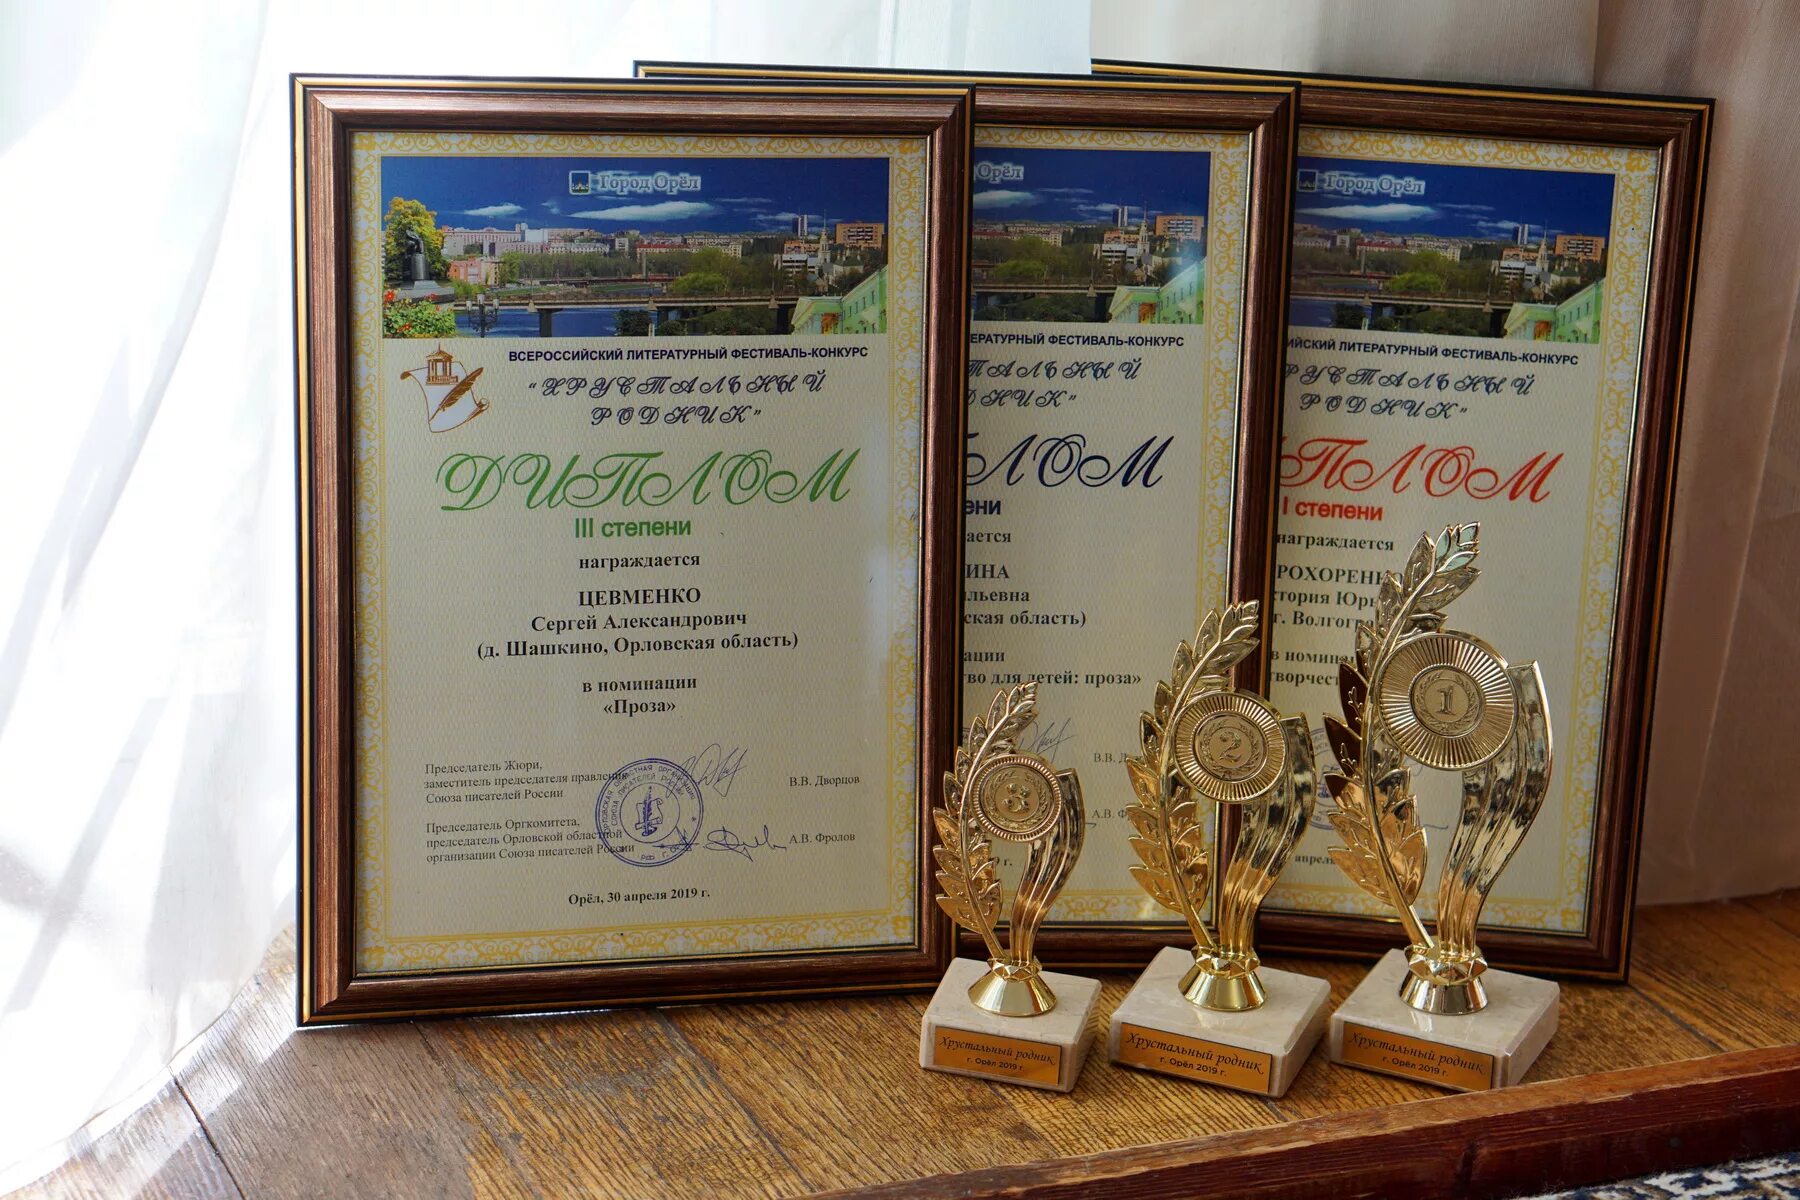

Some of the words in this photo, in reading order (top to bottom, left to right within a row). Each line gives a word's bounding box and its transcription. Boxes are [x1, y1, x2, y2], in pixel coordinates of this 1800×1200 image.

[600, 174, 650, 193] Город
[655, 173, 699, 193] Орёл
[977, 163, 1023, 183] Орёл
[1326, 173, 1375, 194] Город
[1380, 177, 1422, 196] Орёл
[1048, 334, 1185, 348] ФЕСТИВАЛЬ-КОНКУРС
[508, 347, 624, 363] ВСЕРОССИЙСКИЙ
[626, 346, 728, 361] ЛИТЕРАТУРНЫЙ
[731, 346, 868, 360] ФЕСТИВАЛЬ-КОНКУРС
[1338, 340, 1438, 358] ЛИТЕРАТУРНЫЙ
[1441, 346, 1580, 366] ФЕСТИВАЛЬ-КОНКУРС
[966, 432, 1175, 488] ЛОМ
[1279, 435, 1565, 503] ПЛОМ
[435, 447, 861, 512] ДИПЛОМ
[1295, 500, 1384, 522] степени
[575, 518, 594, 539] III
[601, 519, 692, 538] степени
[1276, 532, 1395, 552] награждается
[578, 554, 701, 573] награждается
[578, 586, 702, 610] ЦЕВМЕНКО
[965, 591, 1030, 602] льевна
[531, 614, 597, 635] Сергей
[603, 611, 748, 632] Александрович
[1009, 610, 1087, 629] область)
[477, 642, 500, 660] (д.
[506, 639, 609, 659] Шашкино,
[614, 636, 716, 656] Орловская
[721, 631, 799, 651] область)
[582, 681, 593, 693] в
[598, 677, 698, 693] номинации
[991, 672, 1021, 686] для
[1085, 672, 1142, 689] проза»
[1271, 671, 1339, 688] ворчест
[603, 697, 677, 717] «Проза»
[1436, 684, 1456, 716] 1
[1219, 730, 1243, 763] 2
[425, 762, 502, 776] Председатель
[504, 760, 543, 773] Жюри,
[424, 777, 491, 789] заместитель
[494, 774, 568, 788] председателя
[571, 771, 628, 784] правления
[789, 776, 812, 787] В.В.
[815, 775, 860, 787] Дворцов
[426, 792, 462, 804] Союза
[465, 789, 521, 802] писателей
[524, 788, 564, 800] России
[426, 820, 502, 835] Председатель
[426, 836, 500, 850] председатель
[502, 832, 564, 847] Орловской
[566, 829, 623, 842] областной
[789, 833, 812, 845] А.В.
[815, 832, 856, 845] Фролов
[426, 851, 496, 866] организации
[498, 848, 536, 860] Союза
[538, 844, 594, 858] писателей
[597, 844, 636, 855] России
[1294, 854, 1336, 867] апрел
[568, 890, 605, 907] Орёл,
[607, 890, 622, 904] 30
[624, 890, 668, 905] апреля
[670, 887, 699, 901] 2019
[700, 889, 711, 900] г.
[940, 1036, 1014, 1057] Хрустальный
[1015, 1050, 1056, 1067] родник
[1126, 1032, 1214, 1061] Хрустальный
[1215, 1053, 1264, 1076] родник
[1351, 1032, 1436, 1061] Хрустальный
[1438, 1054, 1487, 1076] родник
[998, 1060, 1018, 1071] 2019
[1159, 1056, 1167, 1065] г.
[1169, 1057, 1194, 1071] Орёл
[1196, 1063, 1218, 1076] 2019
[1219, 1068, 1227, 1077] г.
[1382, 1055, 1390, 1064] г.
[1392, 1057, 1416, 1071] Орёл
[1418, 1064, 1440, 1076] 2019
[1441, 1069, 1449, 1078] г.
